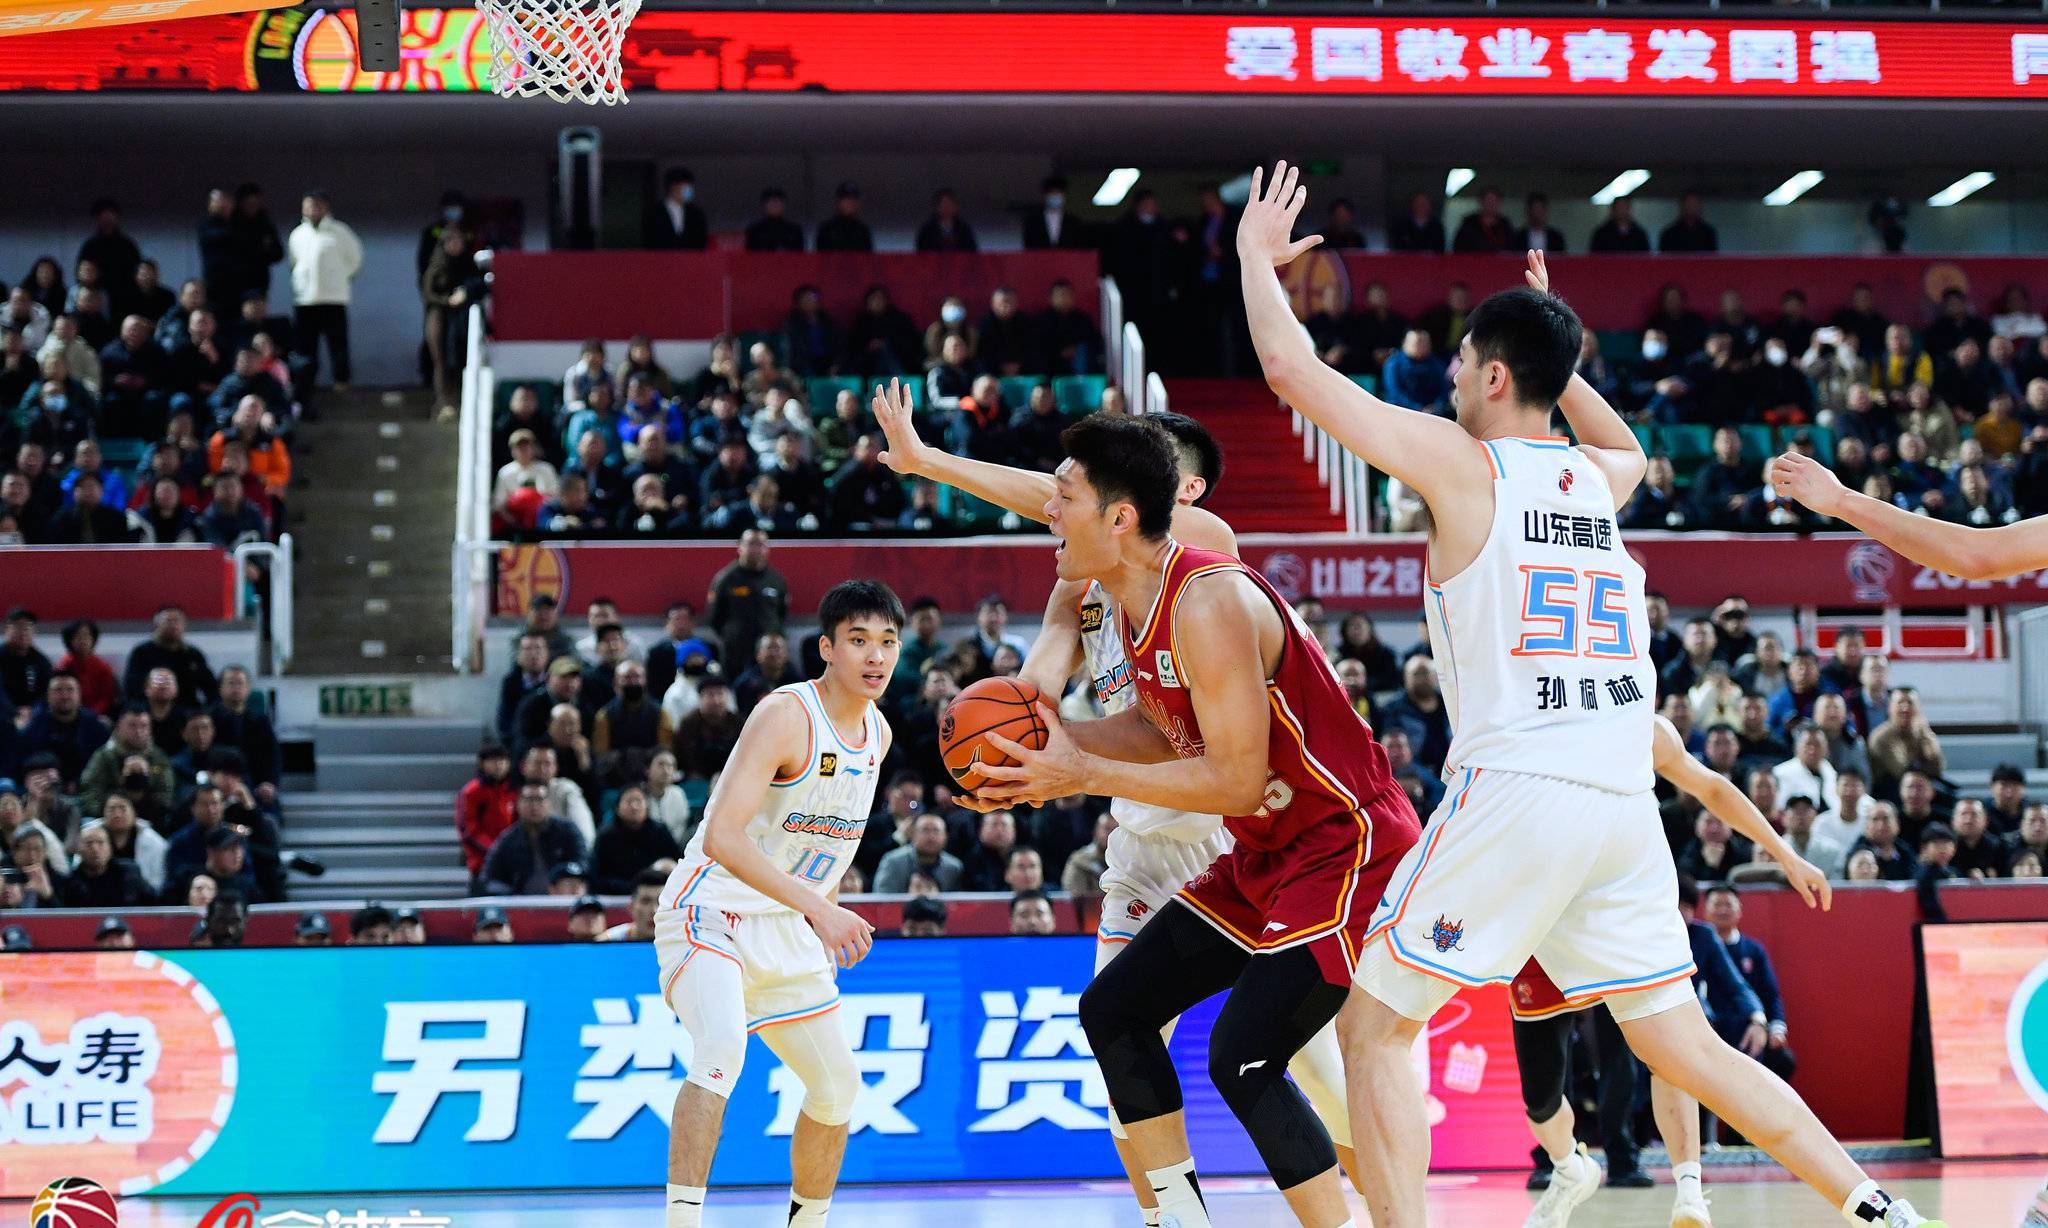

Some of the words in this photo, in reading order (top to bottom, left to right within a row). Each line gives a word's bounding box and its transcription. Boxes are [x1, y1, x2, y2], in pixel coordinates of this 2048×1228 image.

[1225, 27, 1882, 84] 爱国敬业奋发图强
[1524, 510, 1612, 551] 山东高速
[1510, 564, 1638, 660] 55
[1536, 674, 1644, 711] 孙桐林
[785, 847, 839, 884] 10
[26, 1100, 138, 1129] LIFE
